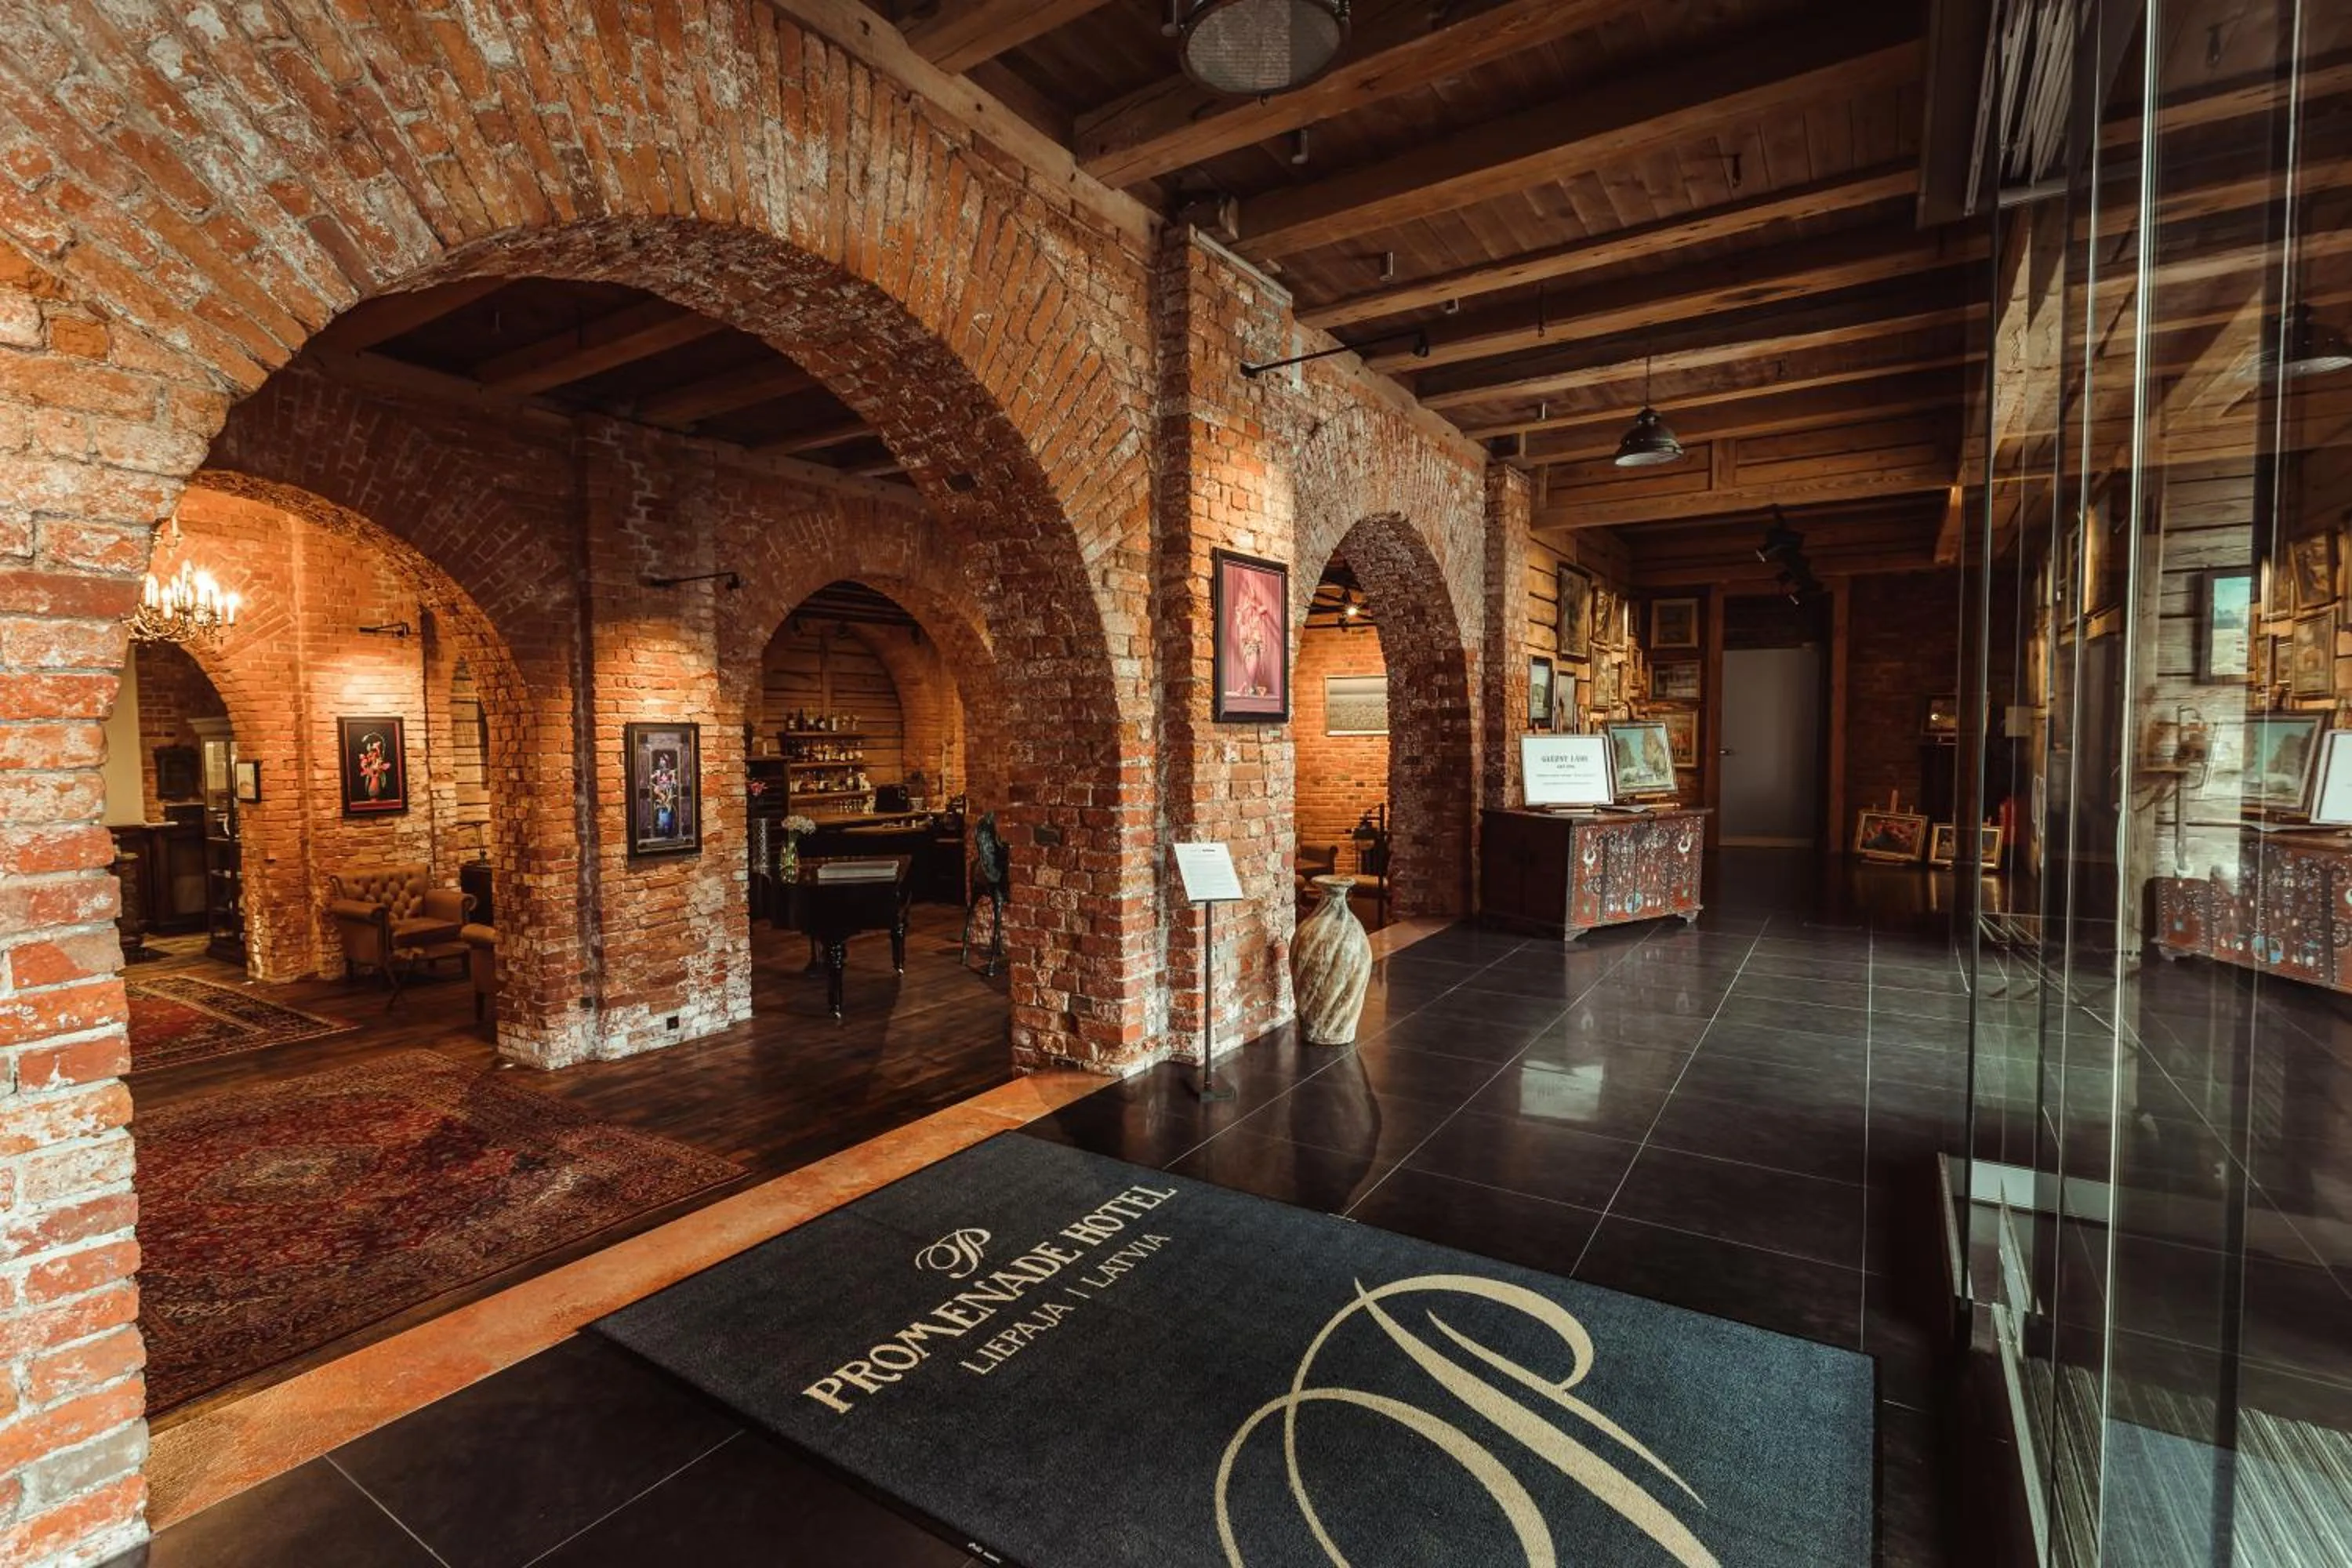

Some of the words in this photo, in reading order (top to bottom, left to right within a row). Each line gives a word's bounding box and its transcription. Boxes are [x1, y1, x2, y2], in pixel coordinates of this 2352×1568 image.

[801, 1241, 1084, 1414] PROMENADE
[1058, 1185, 1178, 1246] HOTEL
[960, 1303, 1075, 1374] LIEPAJA
[1080, 1233, 1171, 1288] LATVIA
